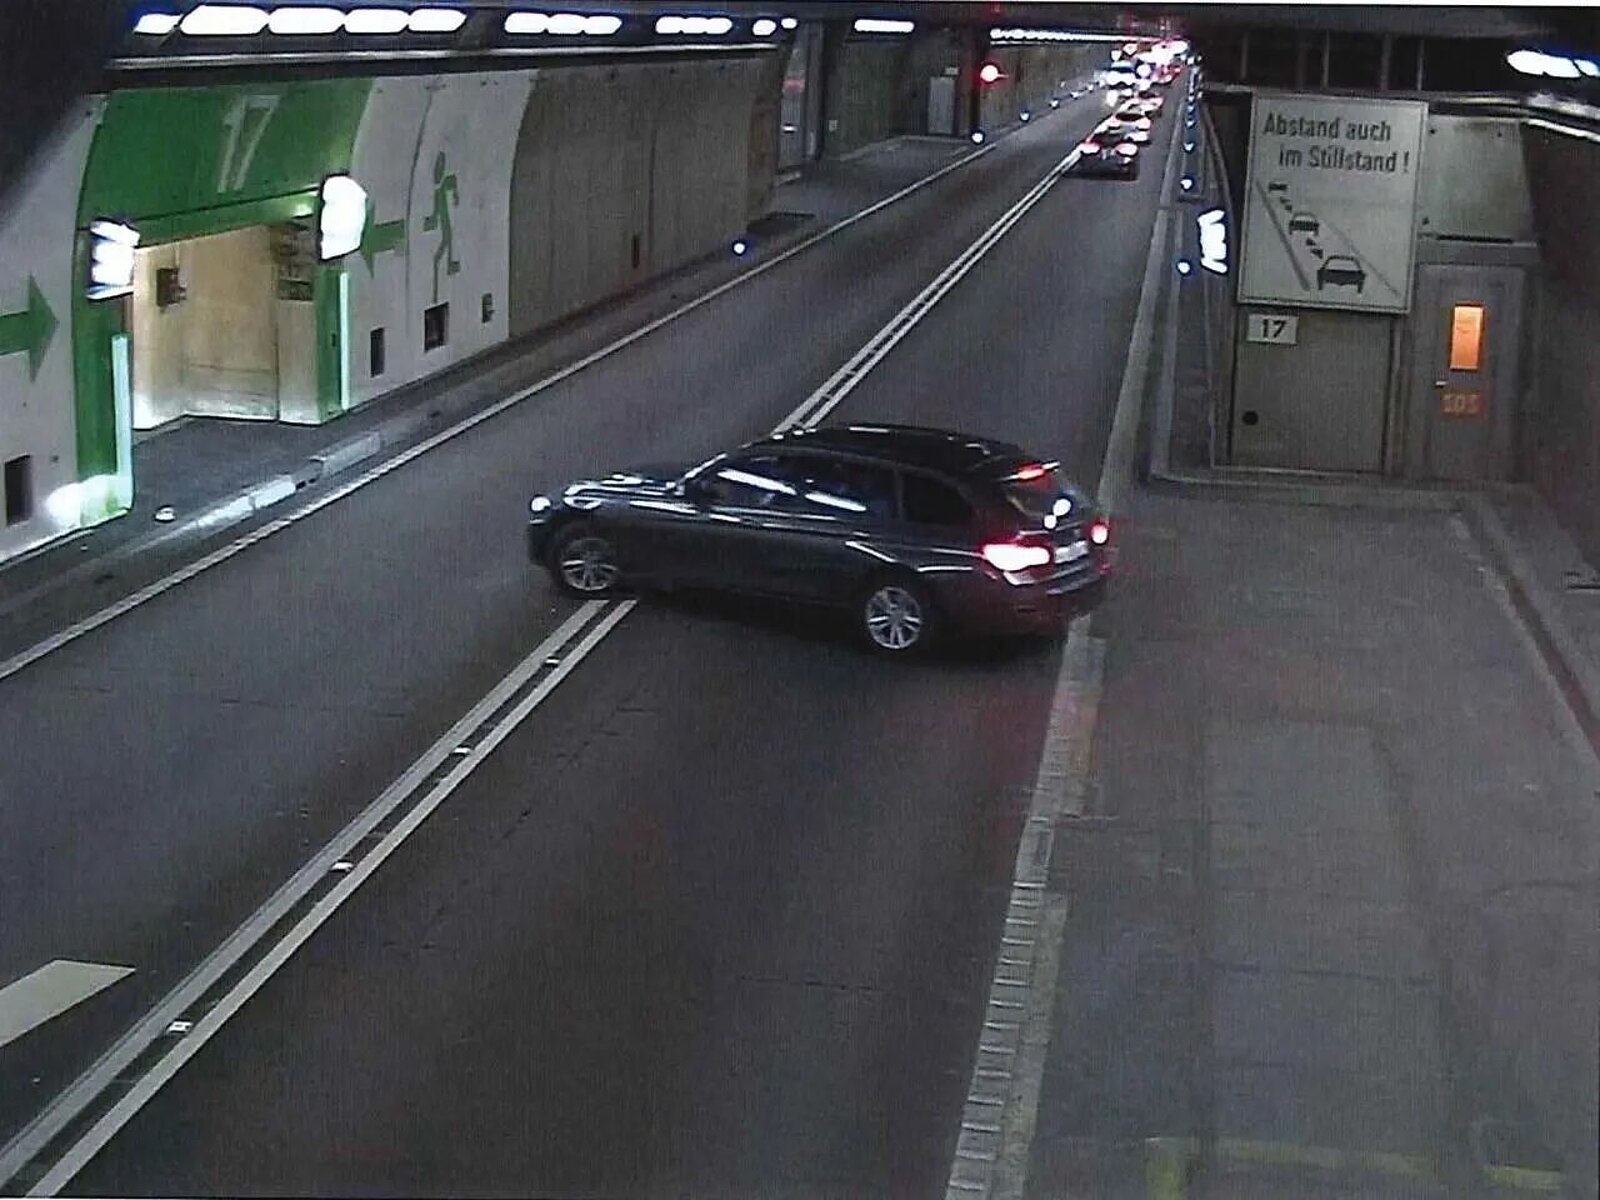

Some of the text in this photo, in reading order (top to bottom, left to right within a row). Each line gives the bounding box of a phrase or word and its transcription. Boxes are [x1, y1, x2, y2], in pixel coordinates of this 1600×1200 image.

[1263, 112, 1391, 143] Abstand auch
[217, 94, 279, 193] 17
[1278, 145, 1410, 173] im Stillstand !
[1259, 318, 1287, 339] 17
